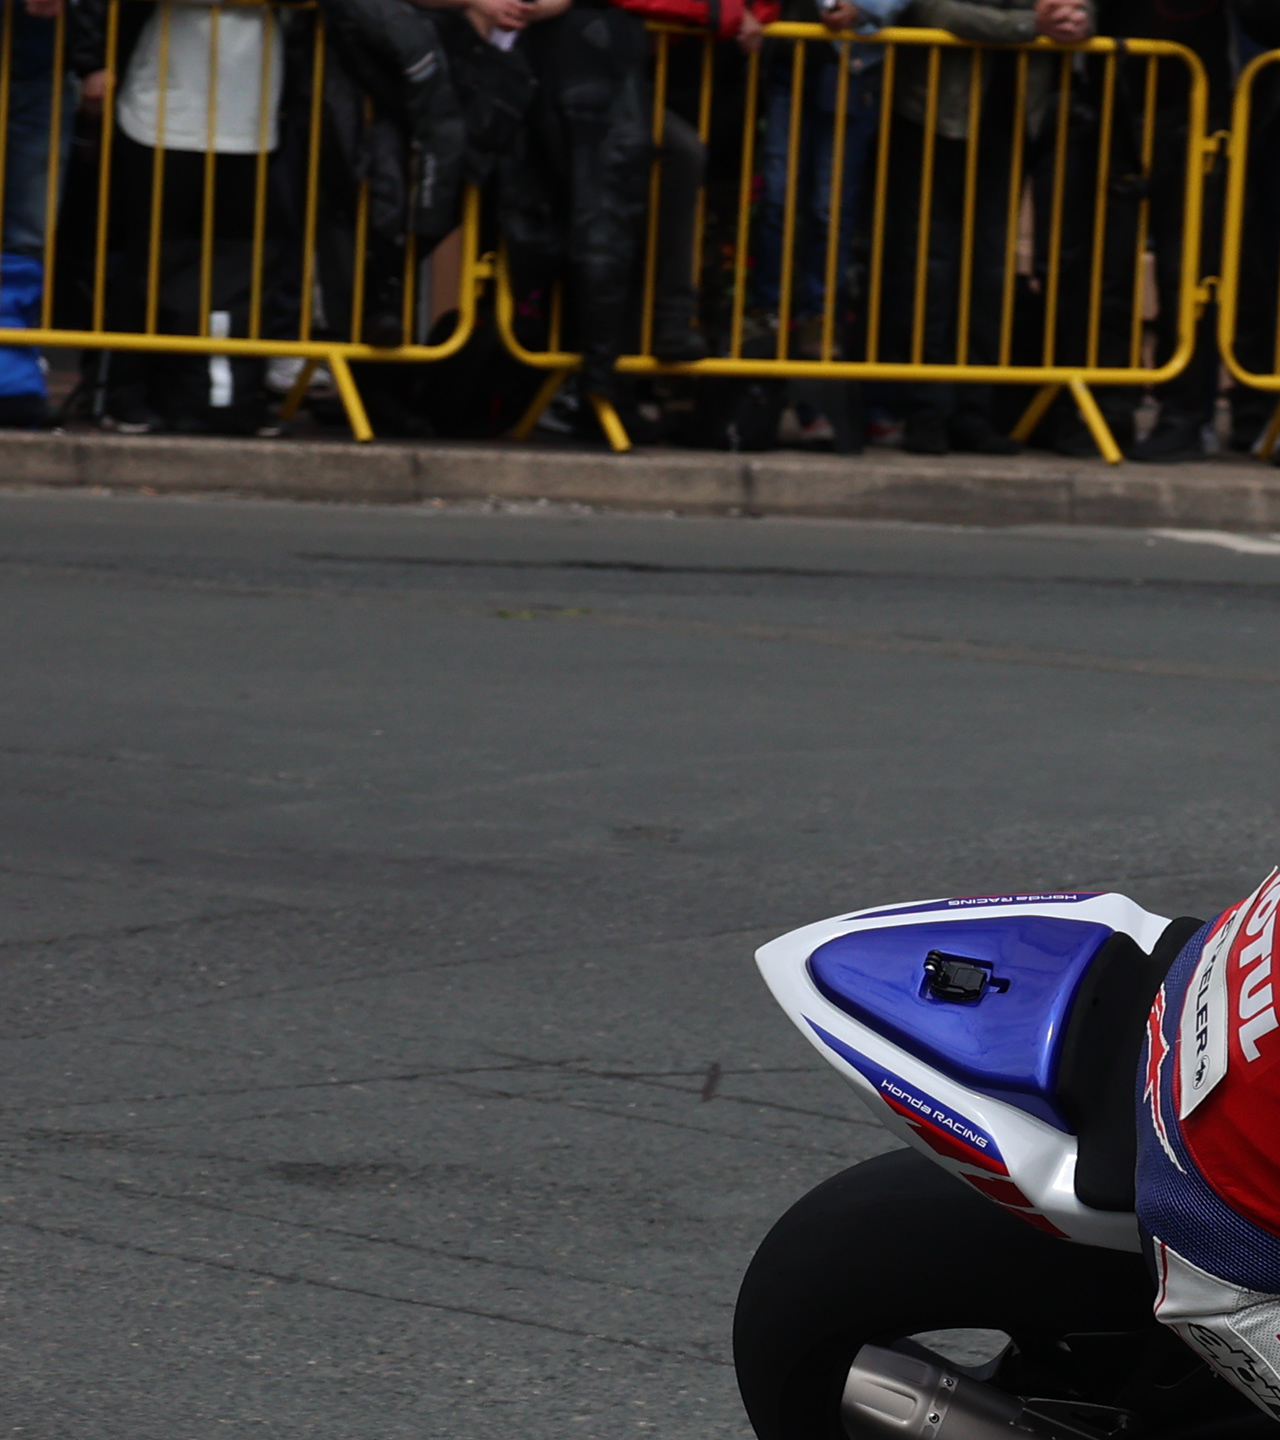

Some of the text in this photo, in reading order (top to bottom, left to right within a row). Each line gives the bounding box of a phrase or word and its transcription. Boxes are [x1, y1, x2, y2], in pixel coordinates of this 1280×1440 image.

[948, 896, 1013, 906] RACING
[881, 1079, 988, 1149] Honda RACING
